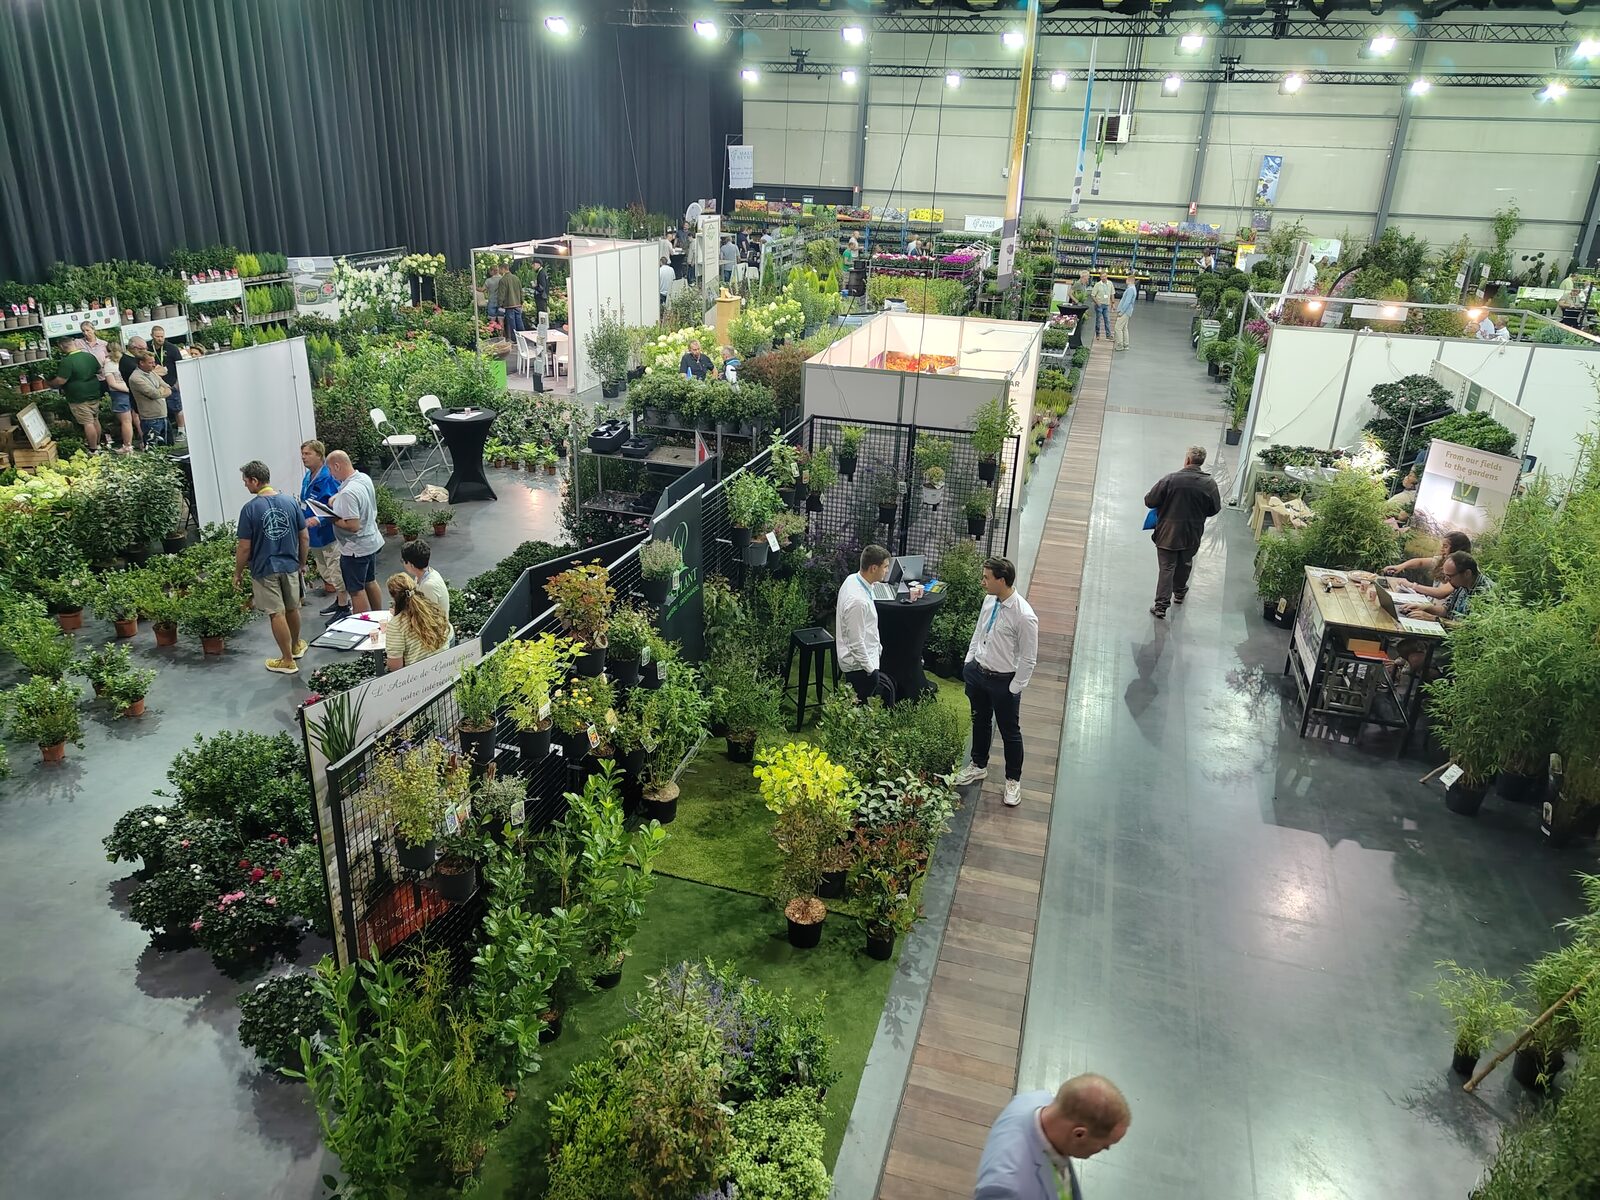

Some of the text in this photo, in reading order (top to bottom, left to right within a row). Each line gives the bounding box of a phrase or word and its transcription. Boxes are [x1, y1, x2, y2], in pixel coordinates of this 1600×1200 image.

[1445, 461, 1498, 480] to the gardens
[1446, 451, 1463, 461] From
[1480, 459, 1503, 471] fields
[400, 689, 420, 703] votre
